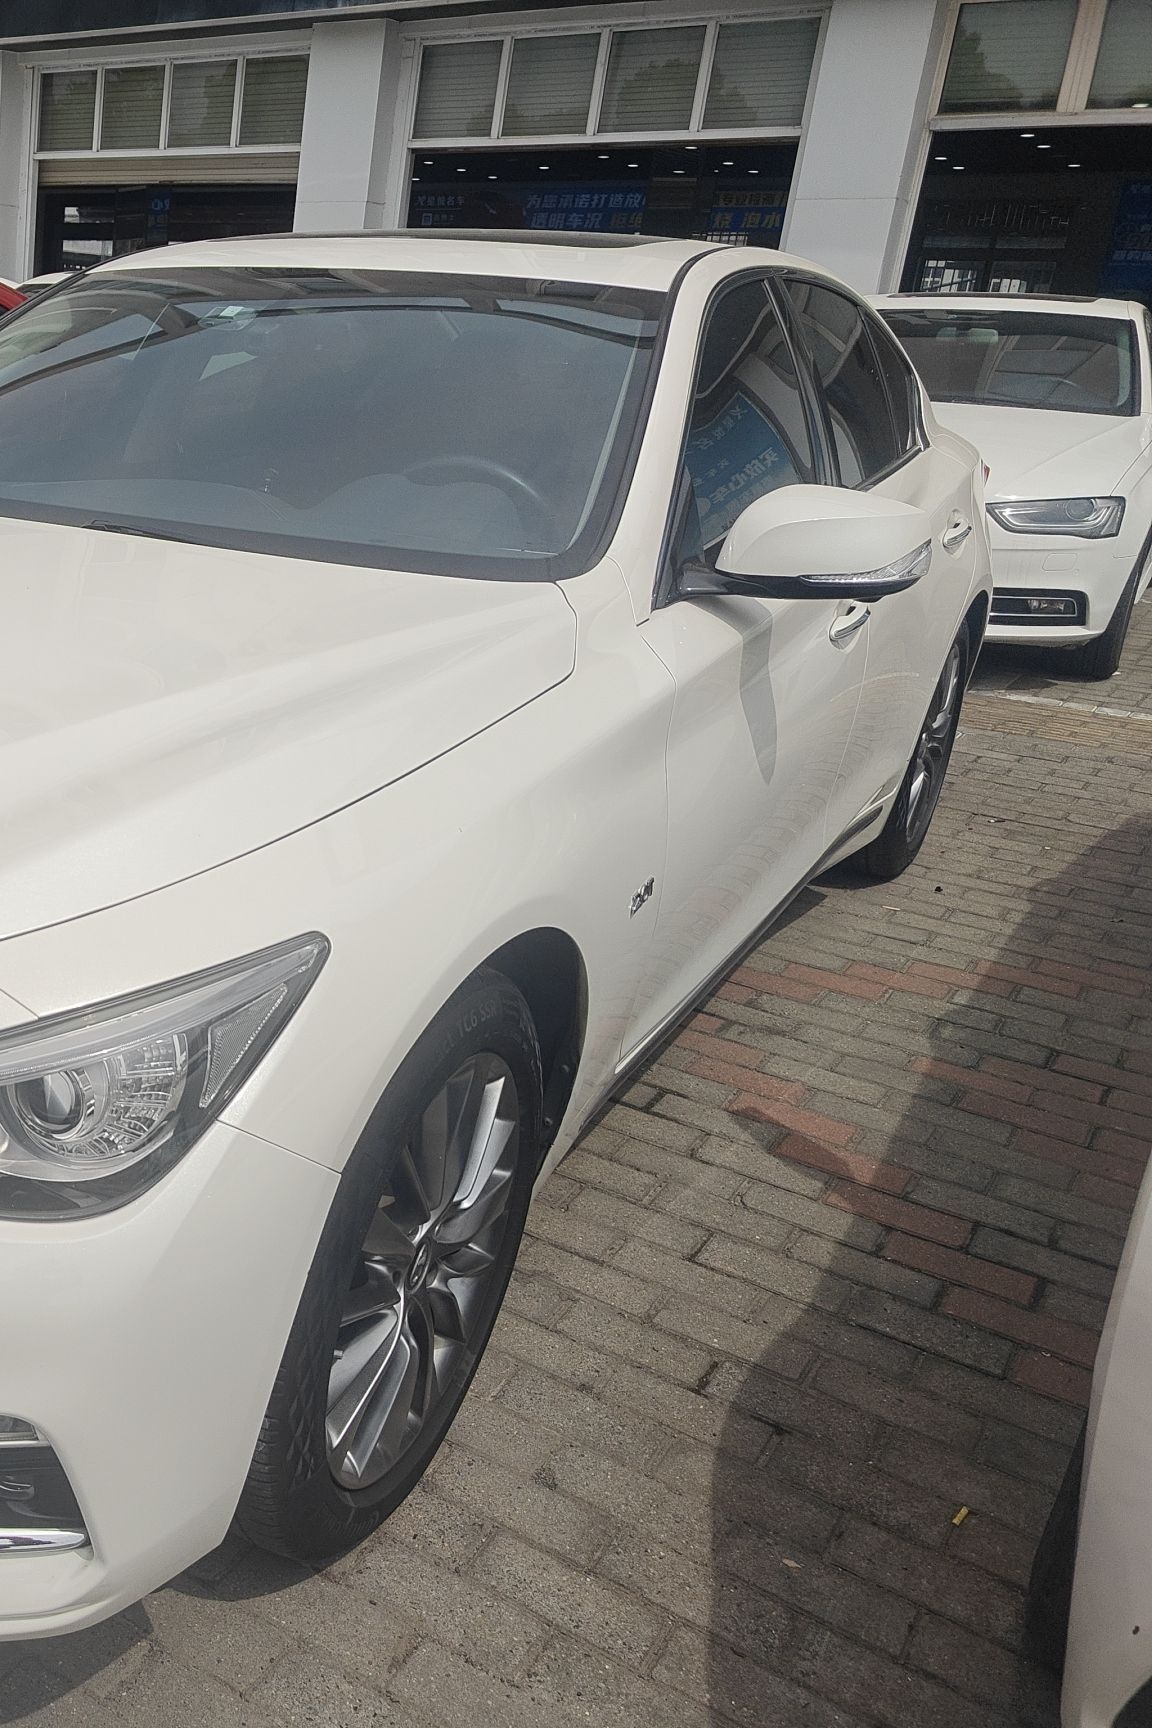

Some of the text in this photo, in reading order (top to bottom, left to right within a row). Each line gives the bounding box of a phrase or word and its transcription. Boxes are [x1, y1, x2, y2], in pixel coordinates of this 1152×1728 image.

[526, 191, 646, 209] 为您承诺打造放
